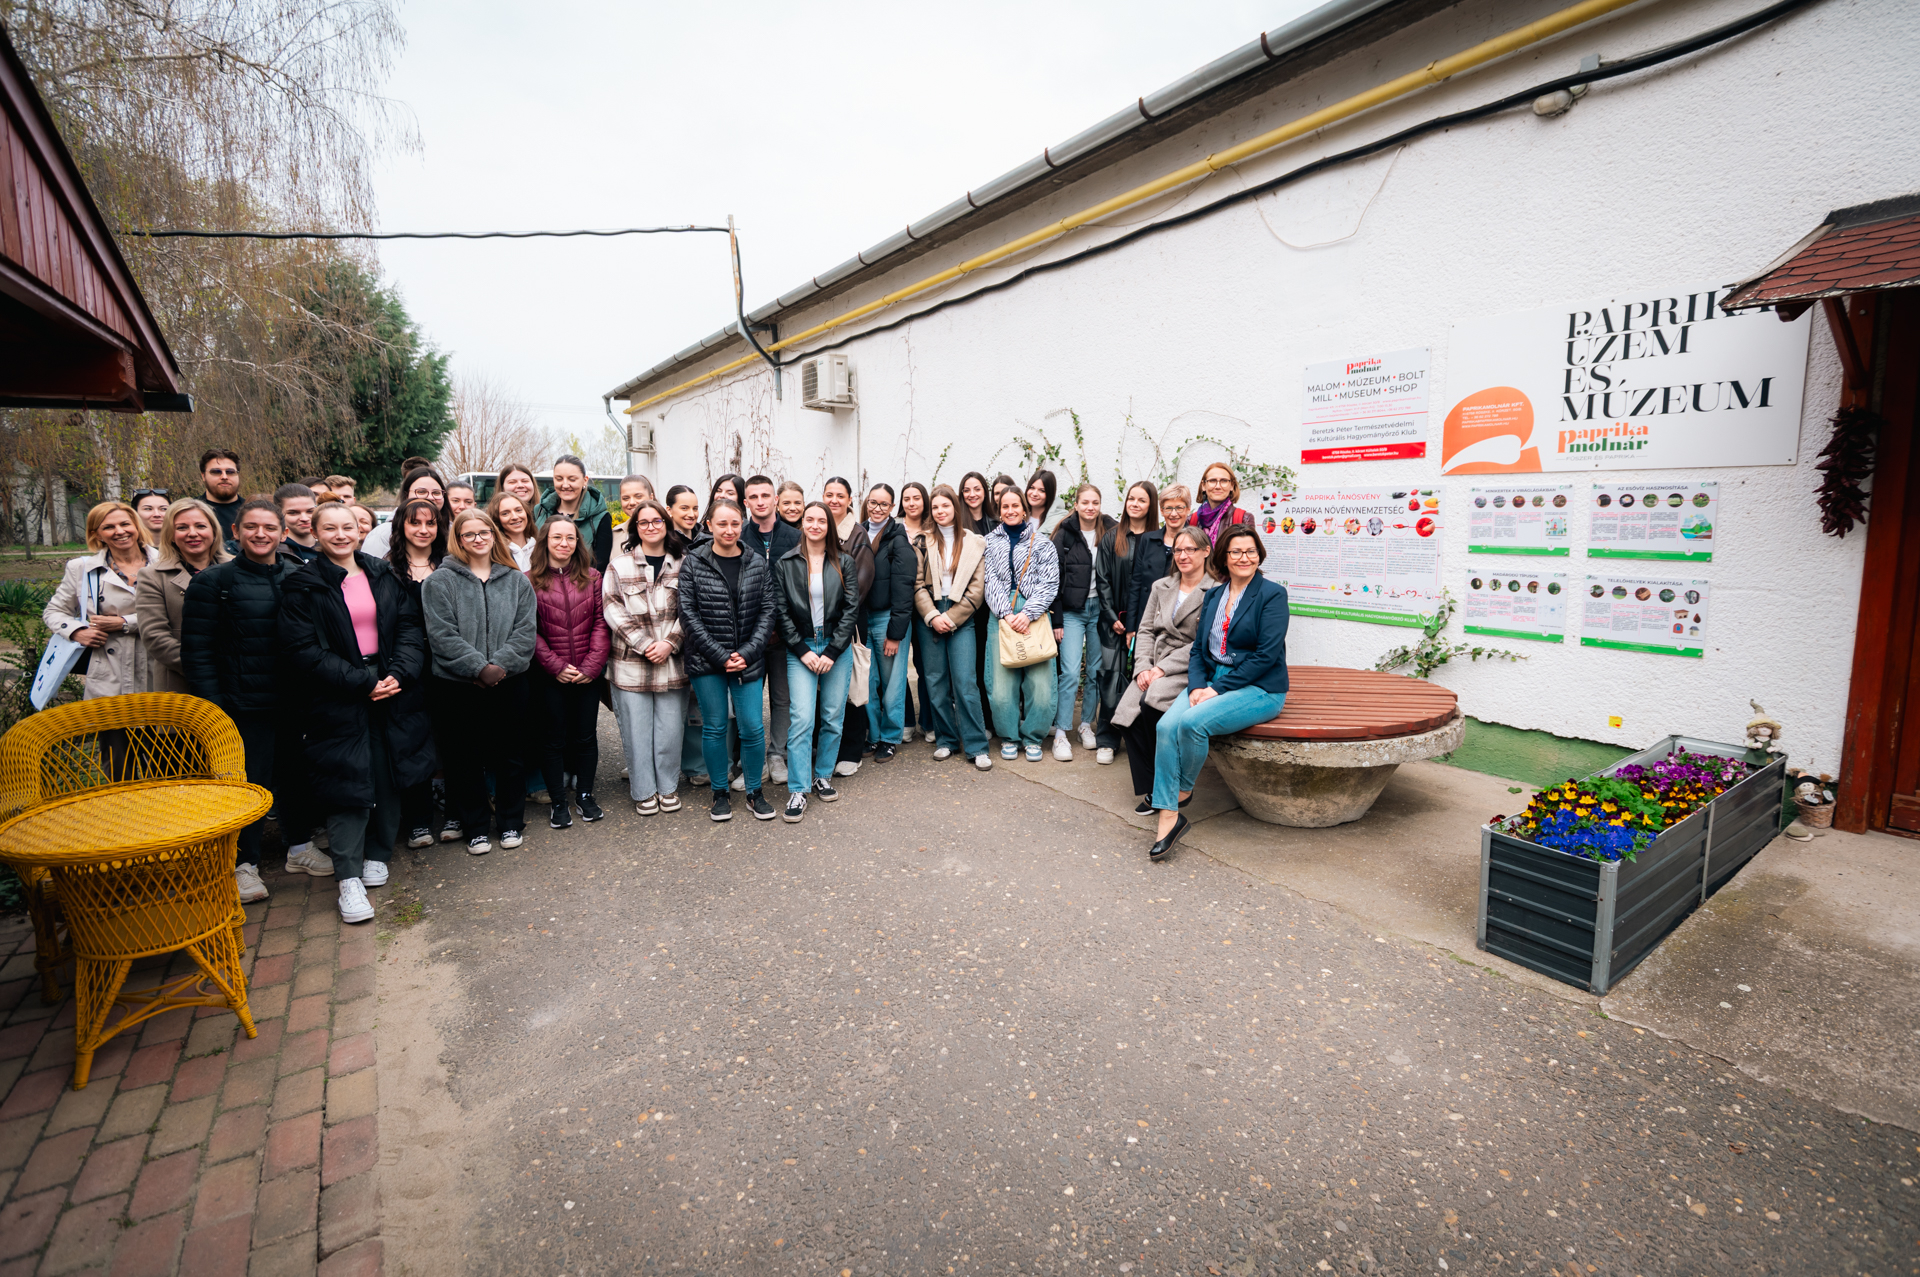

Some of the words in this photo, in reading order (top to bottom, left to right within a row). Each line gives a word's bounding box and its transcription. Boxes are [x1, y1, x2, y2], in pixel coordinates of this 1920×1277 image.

[1564, 287, 1775, 341] PAPRIK
[1564, 324, 1692, 366] ÜZEM
[1308, 382, 1340, 393] MALOM
[1348, 375, 1390, 387] MÚZEUM
[1399, 370, 1425, 381] BOLT
[1561, 355, 1612, 395] ÉS
[1312, 394, 1332, 402] MILL
[1340, 388, 1381, 399] MUSEUM
[1389, 383, 1417, 393] SHOP
[1559, 377, 1777, 422] MÚZEUM
[1463, 403, 1510, 412] PAPRIKAMOLNÁR
[1347, 430, 1399, 440] Hagyományőrző
[1354, 420, 1414, 431] Természetvédelmi
[1569, 436, 1648, 453] molnár
[1324, 505, 1404, 514] NÖVÉNYNEMZETSÉG
[1016, 641, 1027, 660] GOOD
